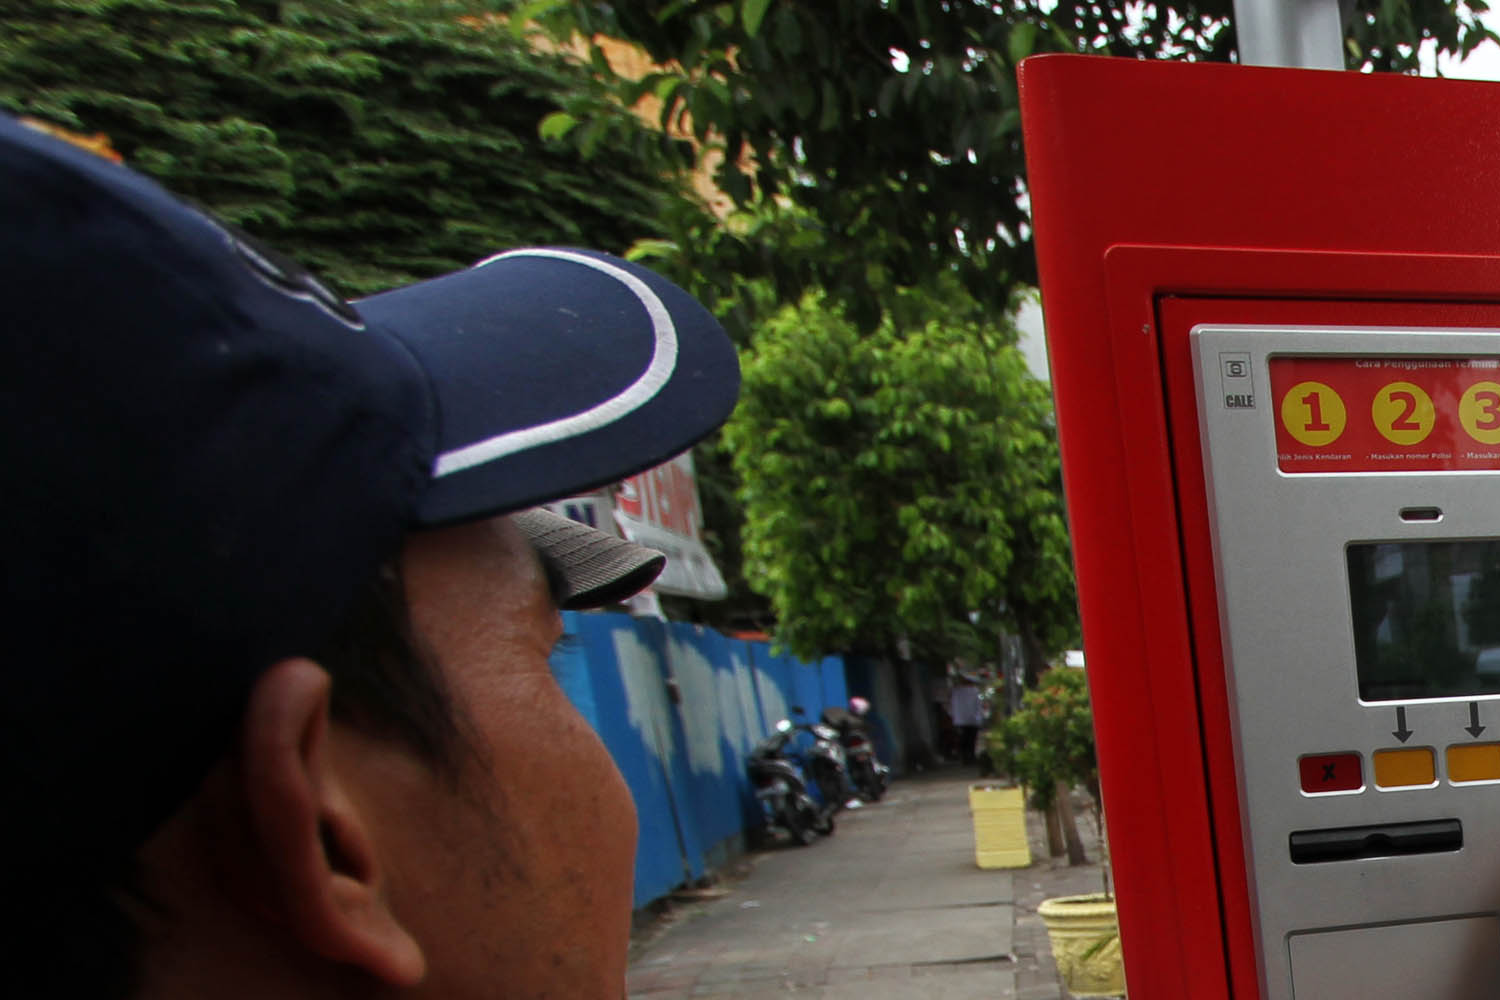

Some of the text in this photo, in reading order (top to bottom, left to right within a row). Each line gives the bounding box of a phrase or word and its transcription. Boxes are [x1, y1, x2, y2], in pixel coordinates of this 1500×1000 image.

[1355, 360, 1381, 369] Cara
[1384, 360, 1451, 370] Penggunaan
[1225, 394, 1254, 408] CALE
[1302, 391, 1331, 432] 1
[1389, 391, 1421, 431] 2
[1371, 453, 1404, 461] Masukan
